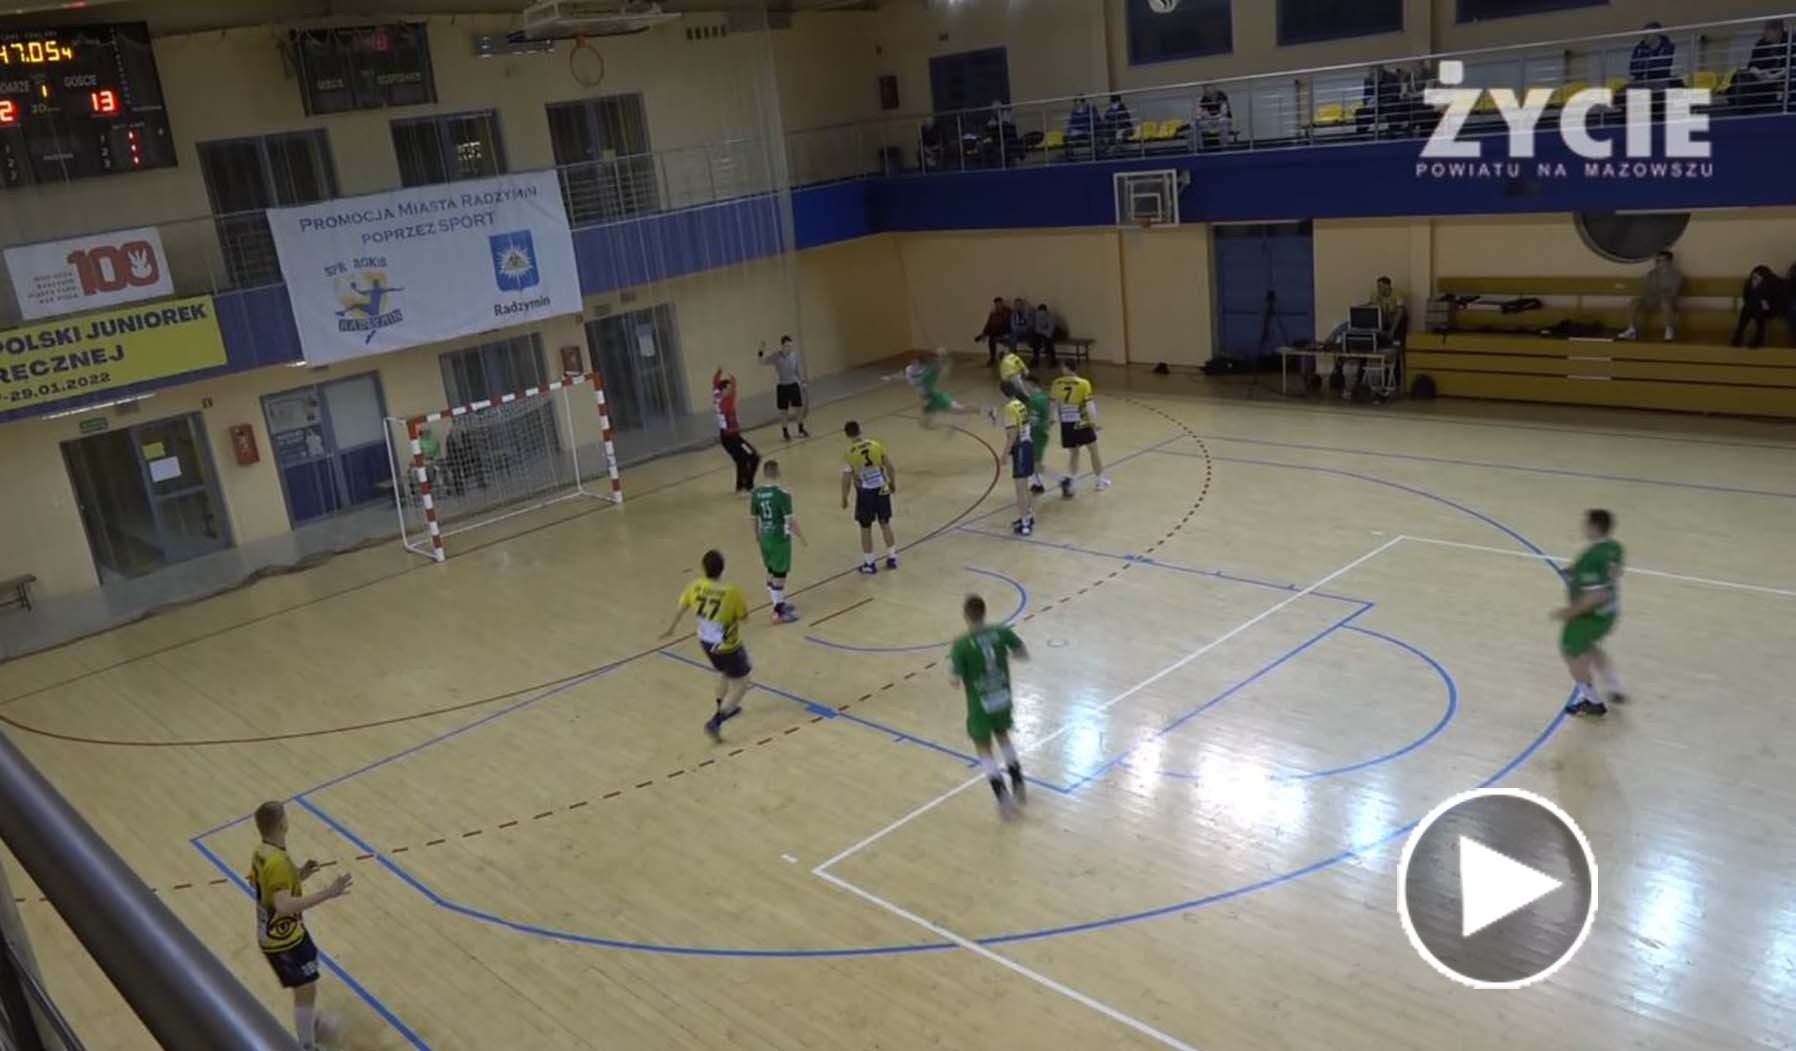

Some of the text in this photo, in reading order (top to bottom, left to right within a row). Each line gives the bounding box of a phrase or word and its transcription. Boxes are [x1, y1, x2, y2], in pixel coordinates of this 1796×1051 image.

[0, 101, 13, 121] 2
[91, 91, 114, 111] 13
[299, 185, 537, 233] PROMOCJA MIASTA RADZYMIN
[361, 210, 496, 245] POPRZEZ SPORT
[67, 240, 160, 296] 100
[494, 295, 551, 317] Radzymin
[0, 303, 208, 355] OLSKI JUNIOREK
[1063, 386, 1073, 403] 7
